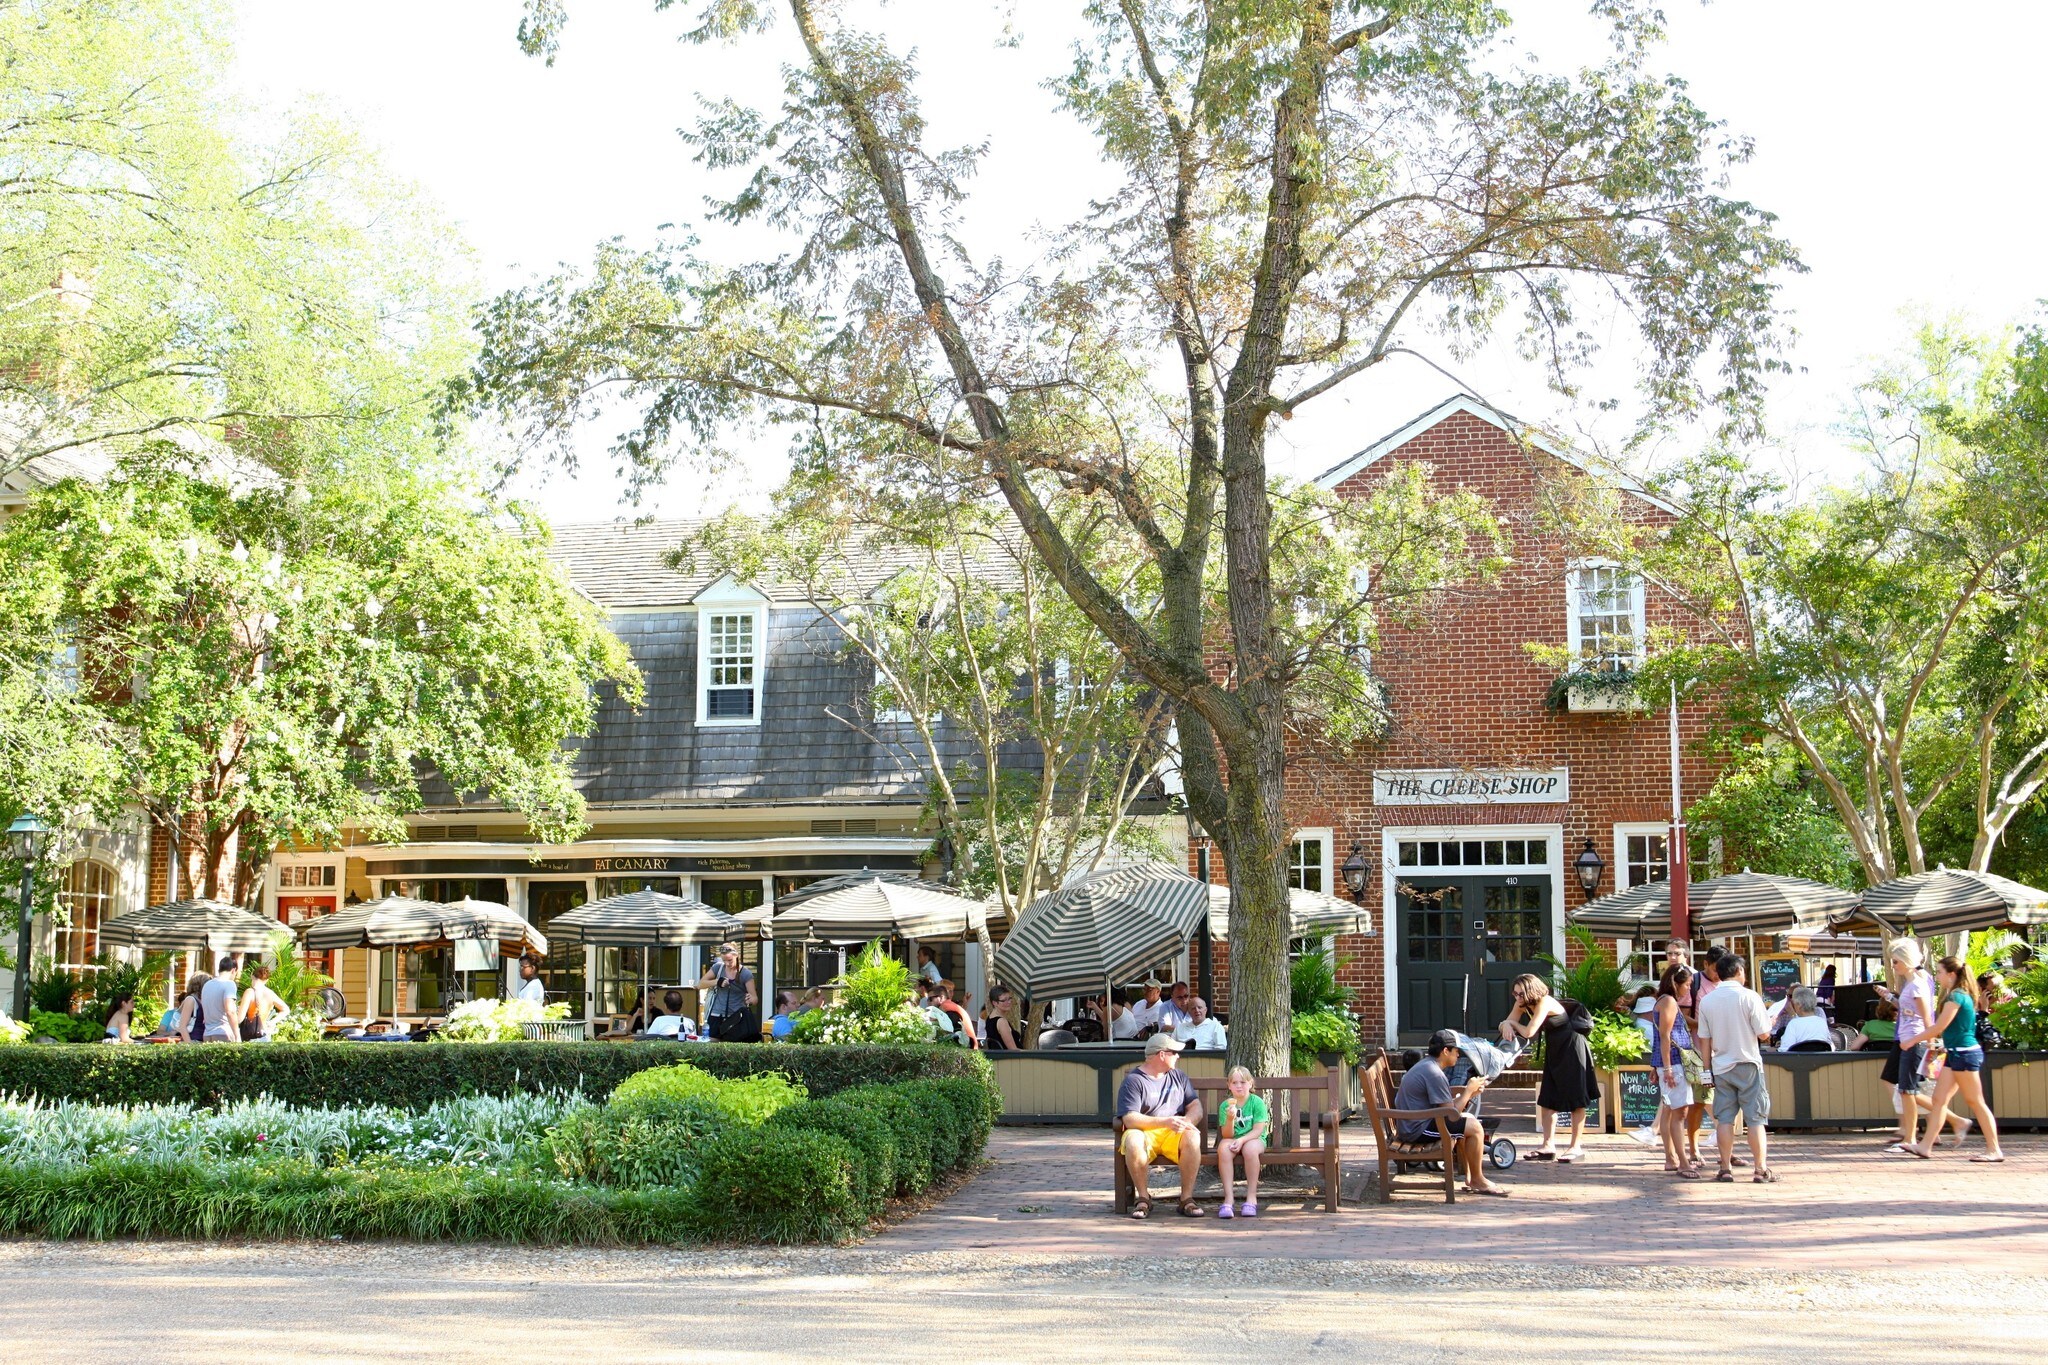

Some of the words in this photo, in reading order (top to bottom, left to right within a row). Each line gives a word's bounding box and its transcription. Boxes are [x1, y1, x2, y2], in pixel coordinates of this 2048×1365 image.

[1386, 779, 1423, 796] THE
[1429, 778, 1502, 796] CHEESE
[1509, 777, 1557, 794] SHOP
[595, 858, 612, 871] FAT
[614, 858, 670, 870] CANARY
[1505, 876, 1518, 886] 410
[303, 896, 315, 904] 402
[1628, 1085, 1658, 1095] HIRING
